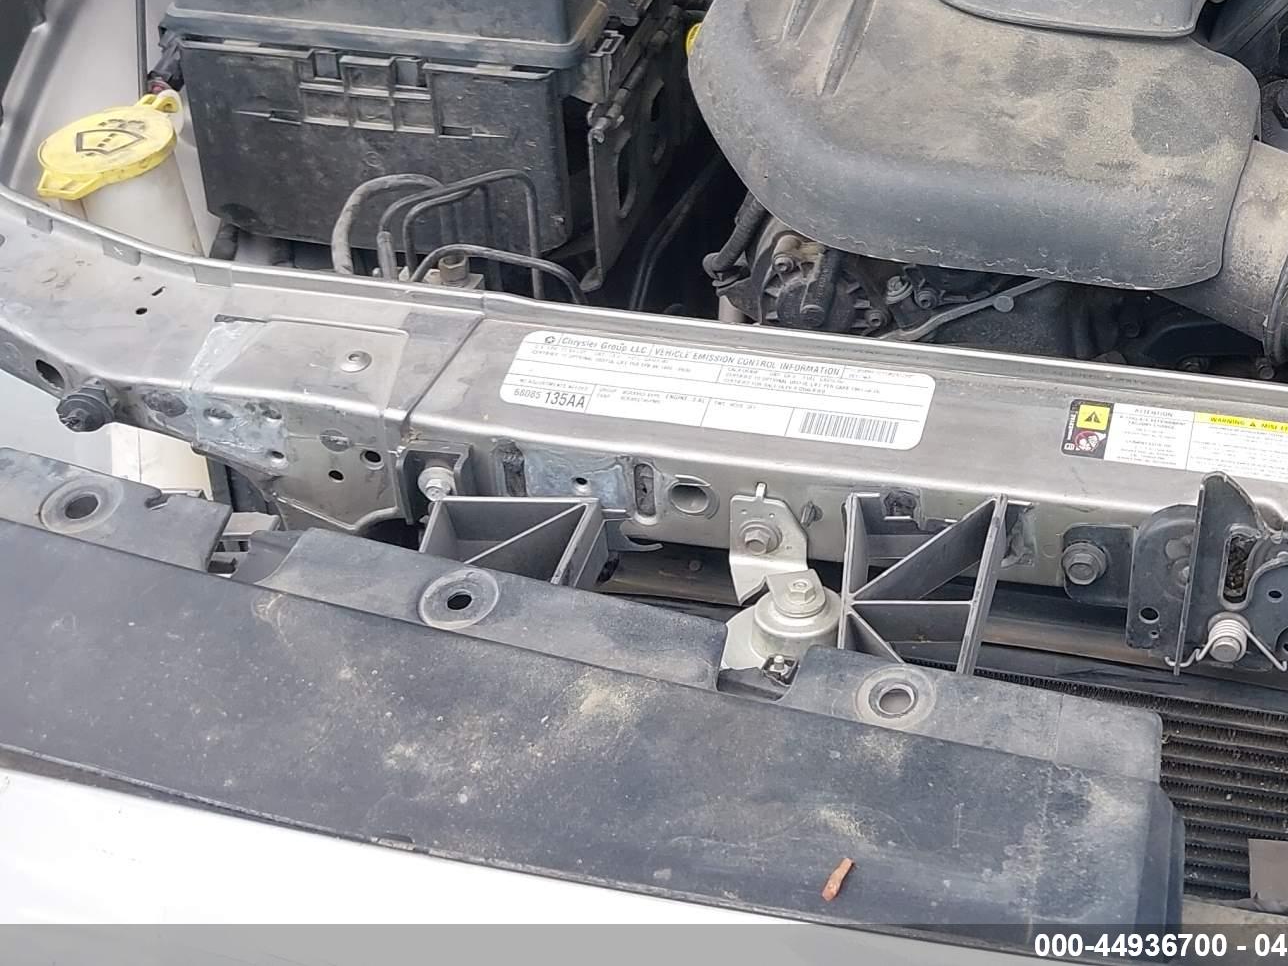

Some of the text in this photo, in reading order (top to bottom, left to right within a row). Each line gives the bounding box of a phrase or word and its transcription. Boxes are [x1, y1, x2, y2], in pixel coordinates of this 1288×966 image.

[561, 336, 648, 355] Chrysler Group LLC
[654, 347, 690, 360] VEHICLE
[692, 352, 735, 364] EMISSION
[737, 357, 777, 370] CONTROL
[779, 361, 841, 376] INFORMATION
[544, 391, 586, 409] 135AA
[1210, 417, 1246, 426] WARNING
